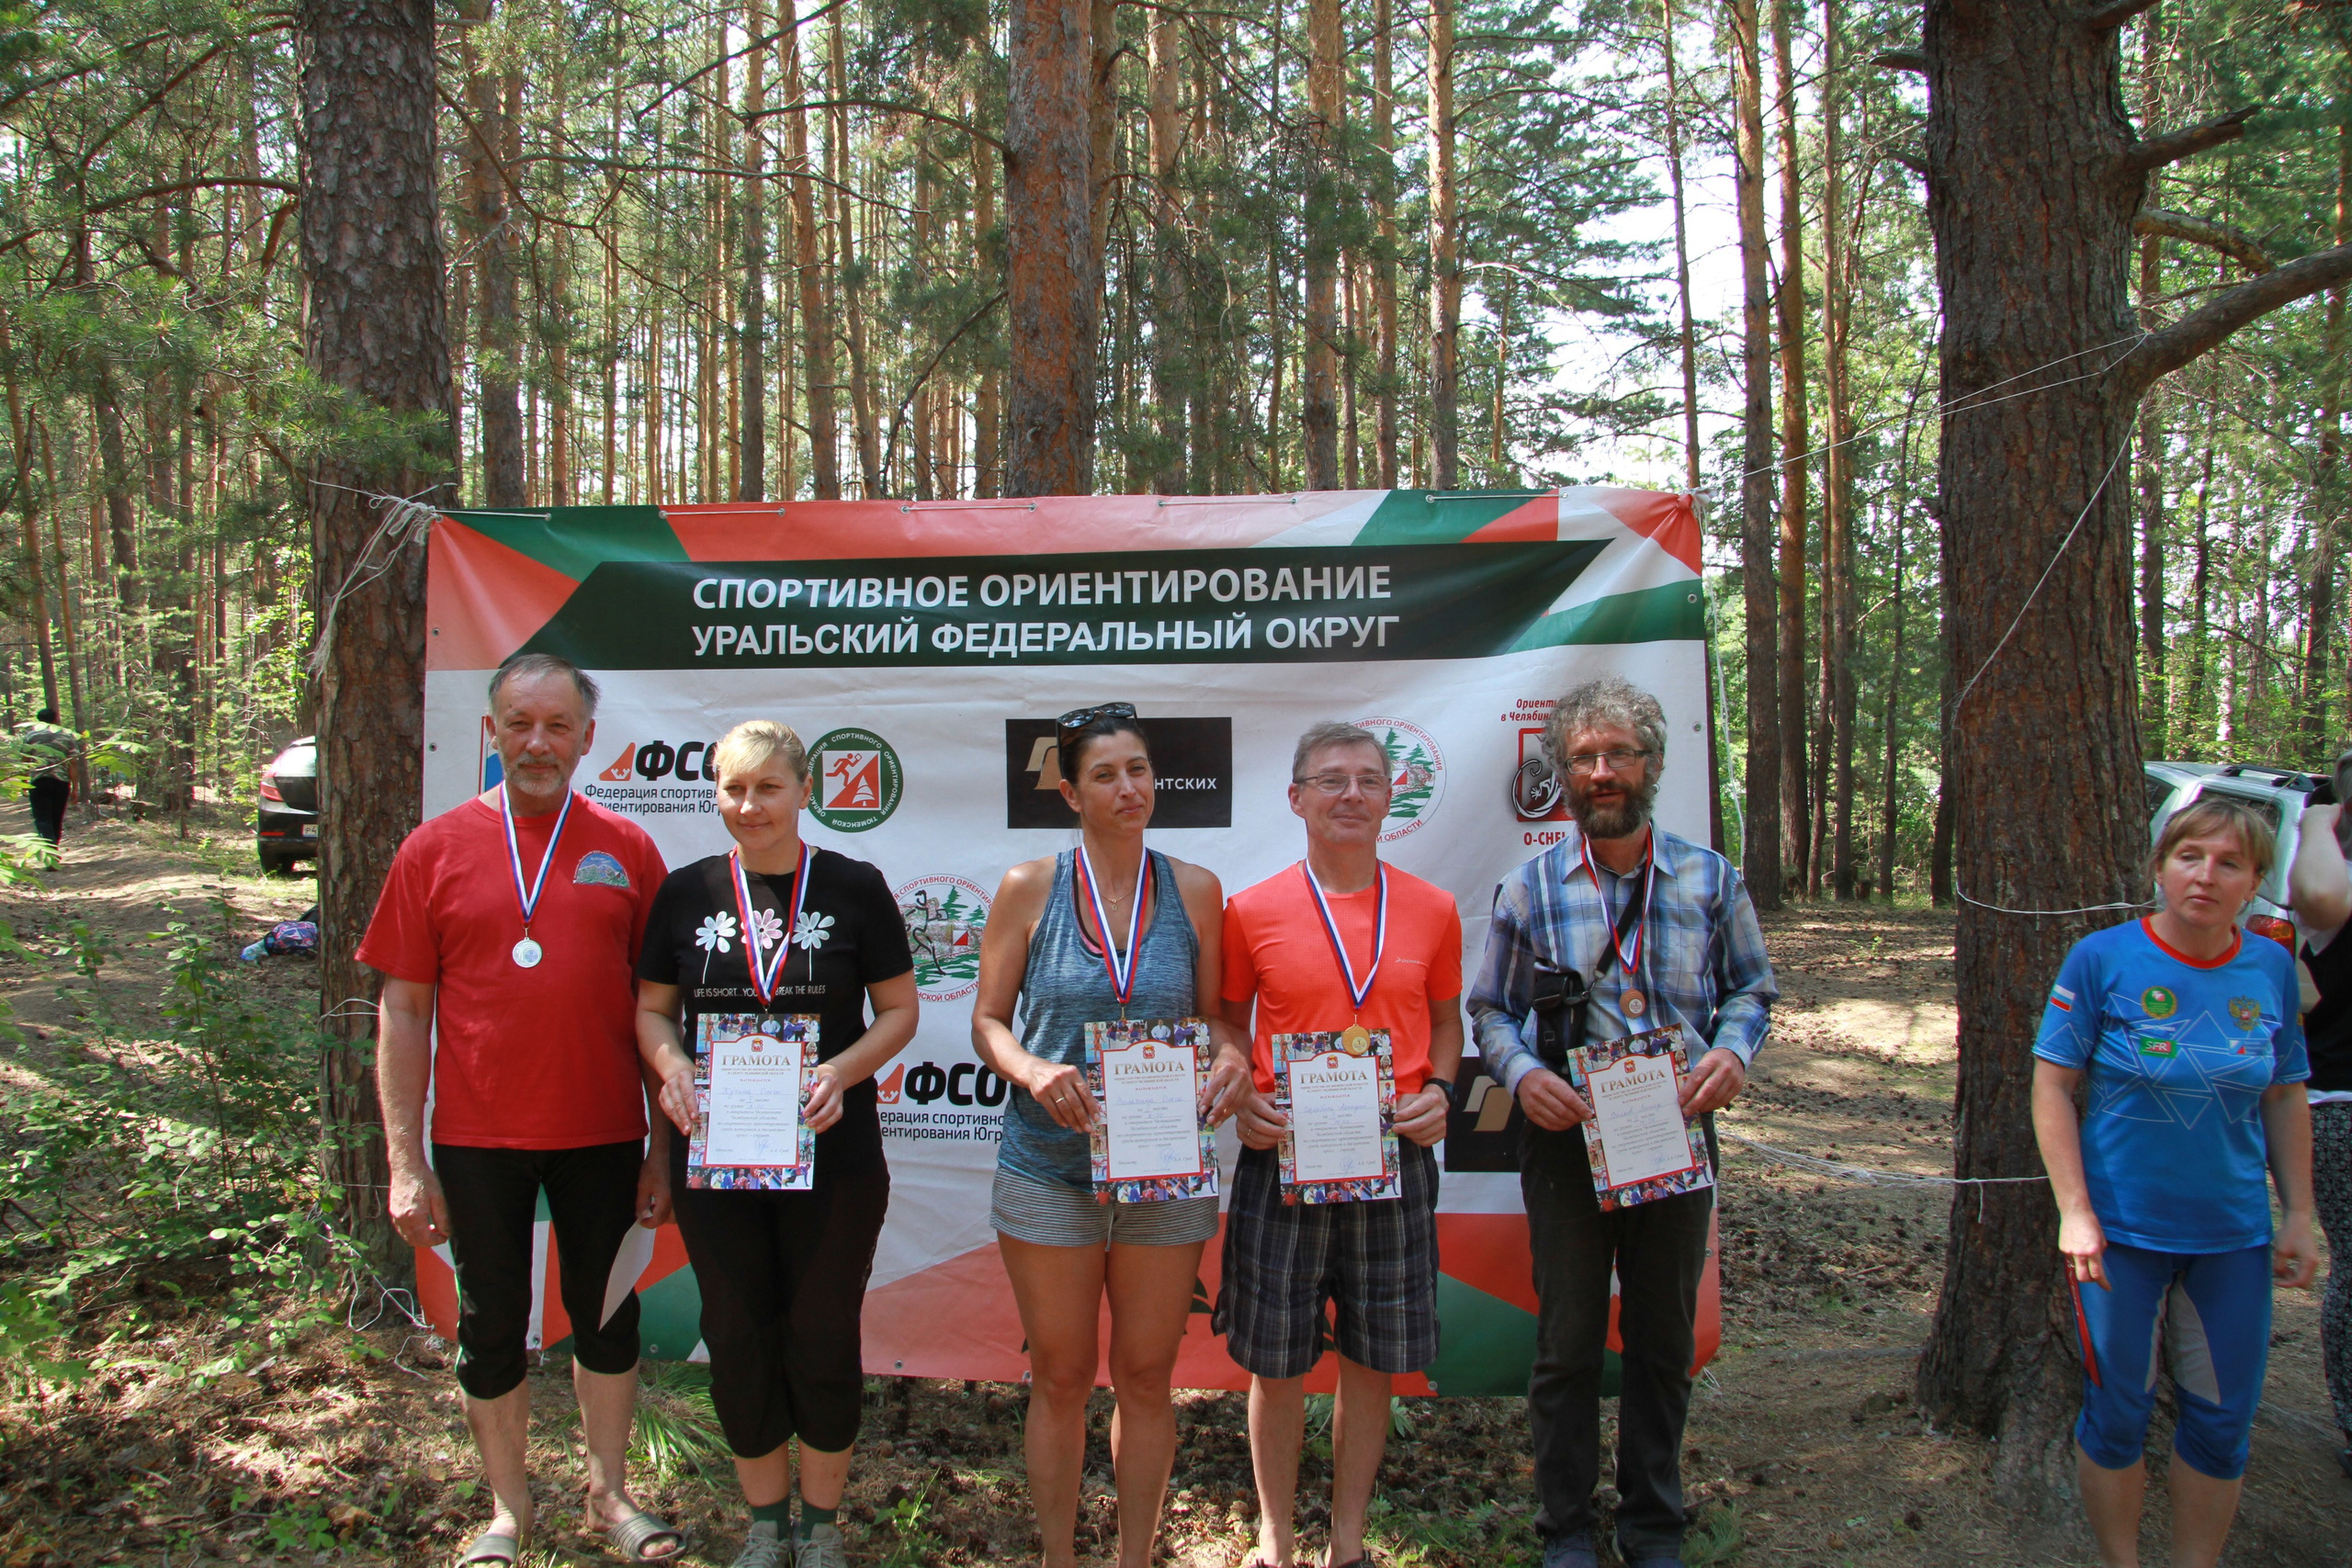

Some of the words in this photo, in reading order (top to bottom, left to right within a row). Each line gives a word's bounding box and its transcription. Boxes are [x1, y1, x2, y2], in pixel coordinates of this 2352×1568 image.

[693, 575, 969, 609] СПОРТИВНОЕ
[979, 565, 1392, 607] ОРИЕНТИРОВАНИЕ
[692, 616, 920, 657] УРАЛЬСКИЙ
[932, 612, 1252, 659] ФЕДЕРАЛЬНЫЙ
[1265, 615, 1400, 649] ОКРУГ
[1500, 714, 1507, 722] в
[1354, 719, 1392, 728] ТИВНОГО
[1394, 721, 1443, 771] ОРИЕНТИРОВАНИЯ
[831, 732, 882, 749] СПОРТИВНОГО
[884, 750, 899, 816] ОРИЕНТИРОВАНИЯ
[585, 784, 658, 801] Федерация
[1154, 778, 1217, 790] НТСКИХ
[809, 791, 826, 817] ОБЛАС
[831, 816, 878, 829] ТЮМЕНСКОЙ
[1385, 818, 1423, 841] ОБЛАСТИ
[899, 875, 956, 896] СПОРТИВНОГО
[796, 986, 806, 995] THE
[808, 985, 826, 995] RULES
[918, 992, 944, 1001] НСКОЙ
[722, 1055, 791, 1066] ГРАМОТА
[1114, 1060, 1185, 1076] ГРАМОТА
[904, 1061, 1008, 1107] ФСО
[1300, 1070, 1367, 1084] ГРАМОТА
[1600, 1068, 1666, 1093] ГРАМОТА
[878, 1111, 929, 1125] ерация
[882, 1126, 970, 1141] ентирования
[974, 1126, 1003, 1145] Югр
